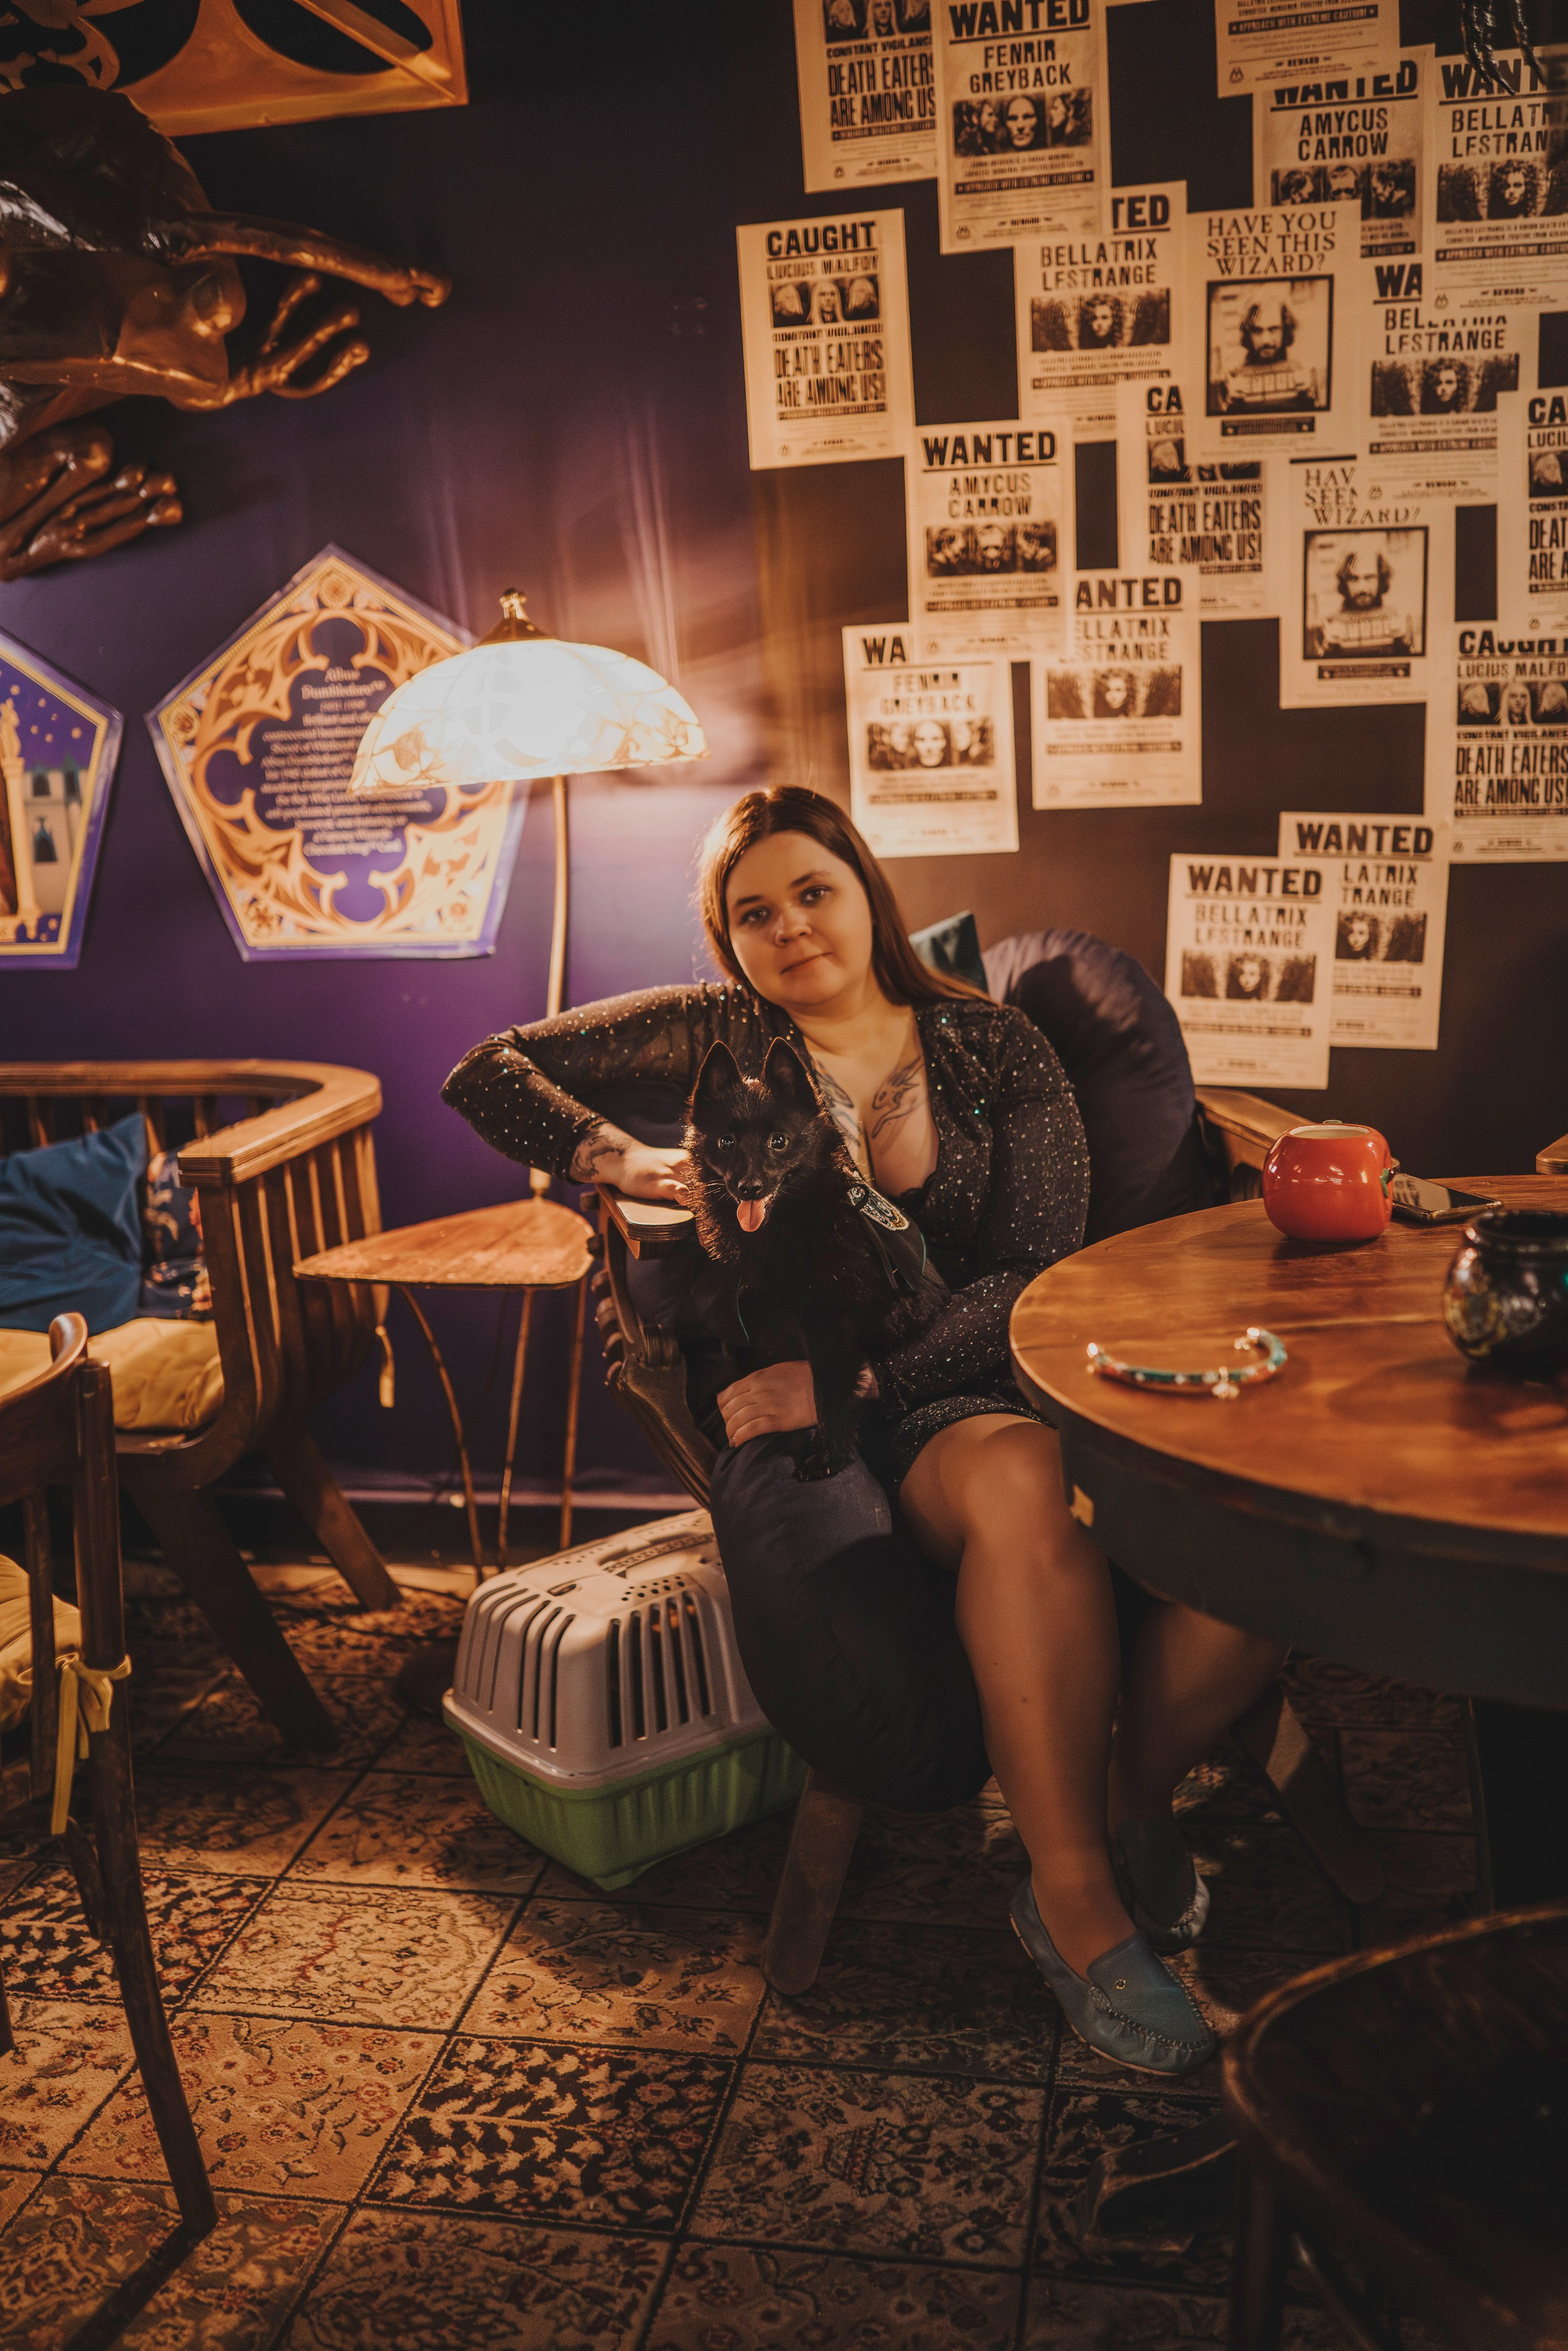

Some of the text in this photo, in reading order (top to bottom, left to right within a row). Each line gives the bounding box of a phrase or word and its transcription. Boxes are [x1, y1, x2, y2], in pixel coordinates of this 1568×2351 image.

[949, 0, 1090, 37] WANTED
[1297, 12, 1331, 25] EXTREME
[984, 39, 1056, 69] FENRIR
[829, 59, 875, 97] DEATH
[970, 62, 1071, 93] GREYBACK
[831, 86, 935, 127] ARE AMONG US
[1300, 107, 1388, 137] AMYCUS
[1298, 132, 1389, 161] CARROW
[1207, 214, 1273, 237] HAVE
[1280, 210, 1336, 233] YOU
[767, 221, 875, 257] CAUGHT
[1041, 237, 1157, 268] BELLATRIX
[1207, 235, 1269, 257] SEEN
[1276, 232, 1336, 254] THIS
[1042, 263, 1157, 291] LESTRANGE
[1215, 252, 1325, 276] WIZARD?
[1385, 328, 1506, 355] LESTRANGE
[775, 339, 883, 379] DEATH EATERS
[1147, 385, 1183, 412] CA
[923, 431, 1056, 467] WANTED
[950, 472, 1031, 497] AMYCUS
[948, 495, 1033, 519] CARROW
[1150, 499, 1261, 535] DEATH EATERS
[1312, 505, 1421, 526] WIZARD?
[1150, 536, 1174, 564] ARE
[1529, 551, 1556, 580] ARE
[1077, 576, 1182, 608] ANTED
[862, 636, 907, 664] WA
[1459, 629, 1568, 655] CAUGH
[1457, 662, 1509, 678] LUCIUS
[1456, 744, 1568, 775] DEATH EATERS
[1455, 779, 1479, 805] ARE
[1486, 778, 1540, 805] AMONG
[1297, 823, 1434, 854] WANTED
[1189, 865, 1322, 896] WANTED
[1196, 904, 1308, 927] BELLATRIX
